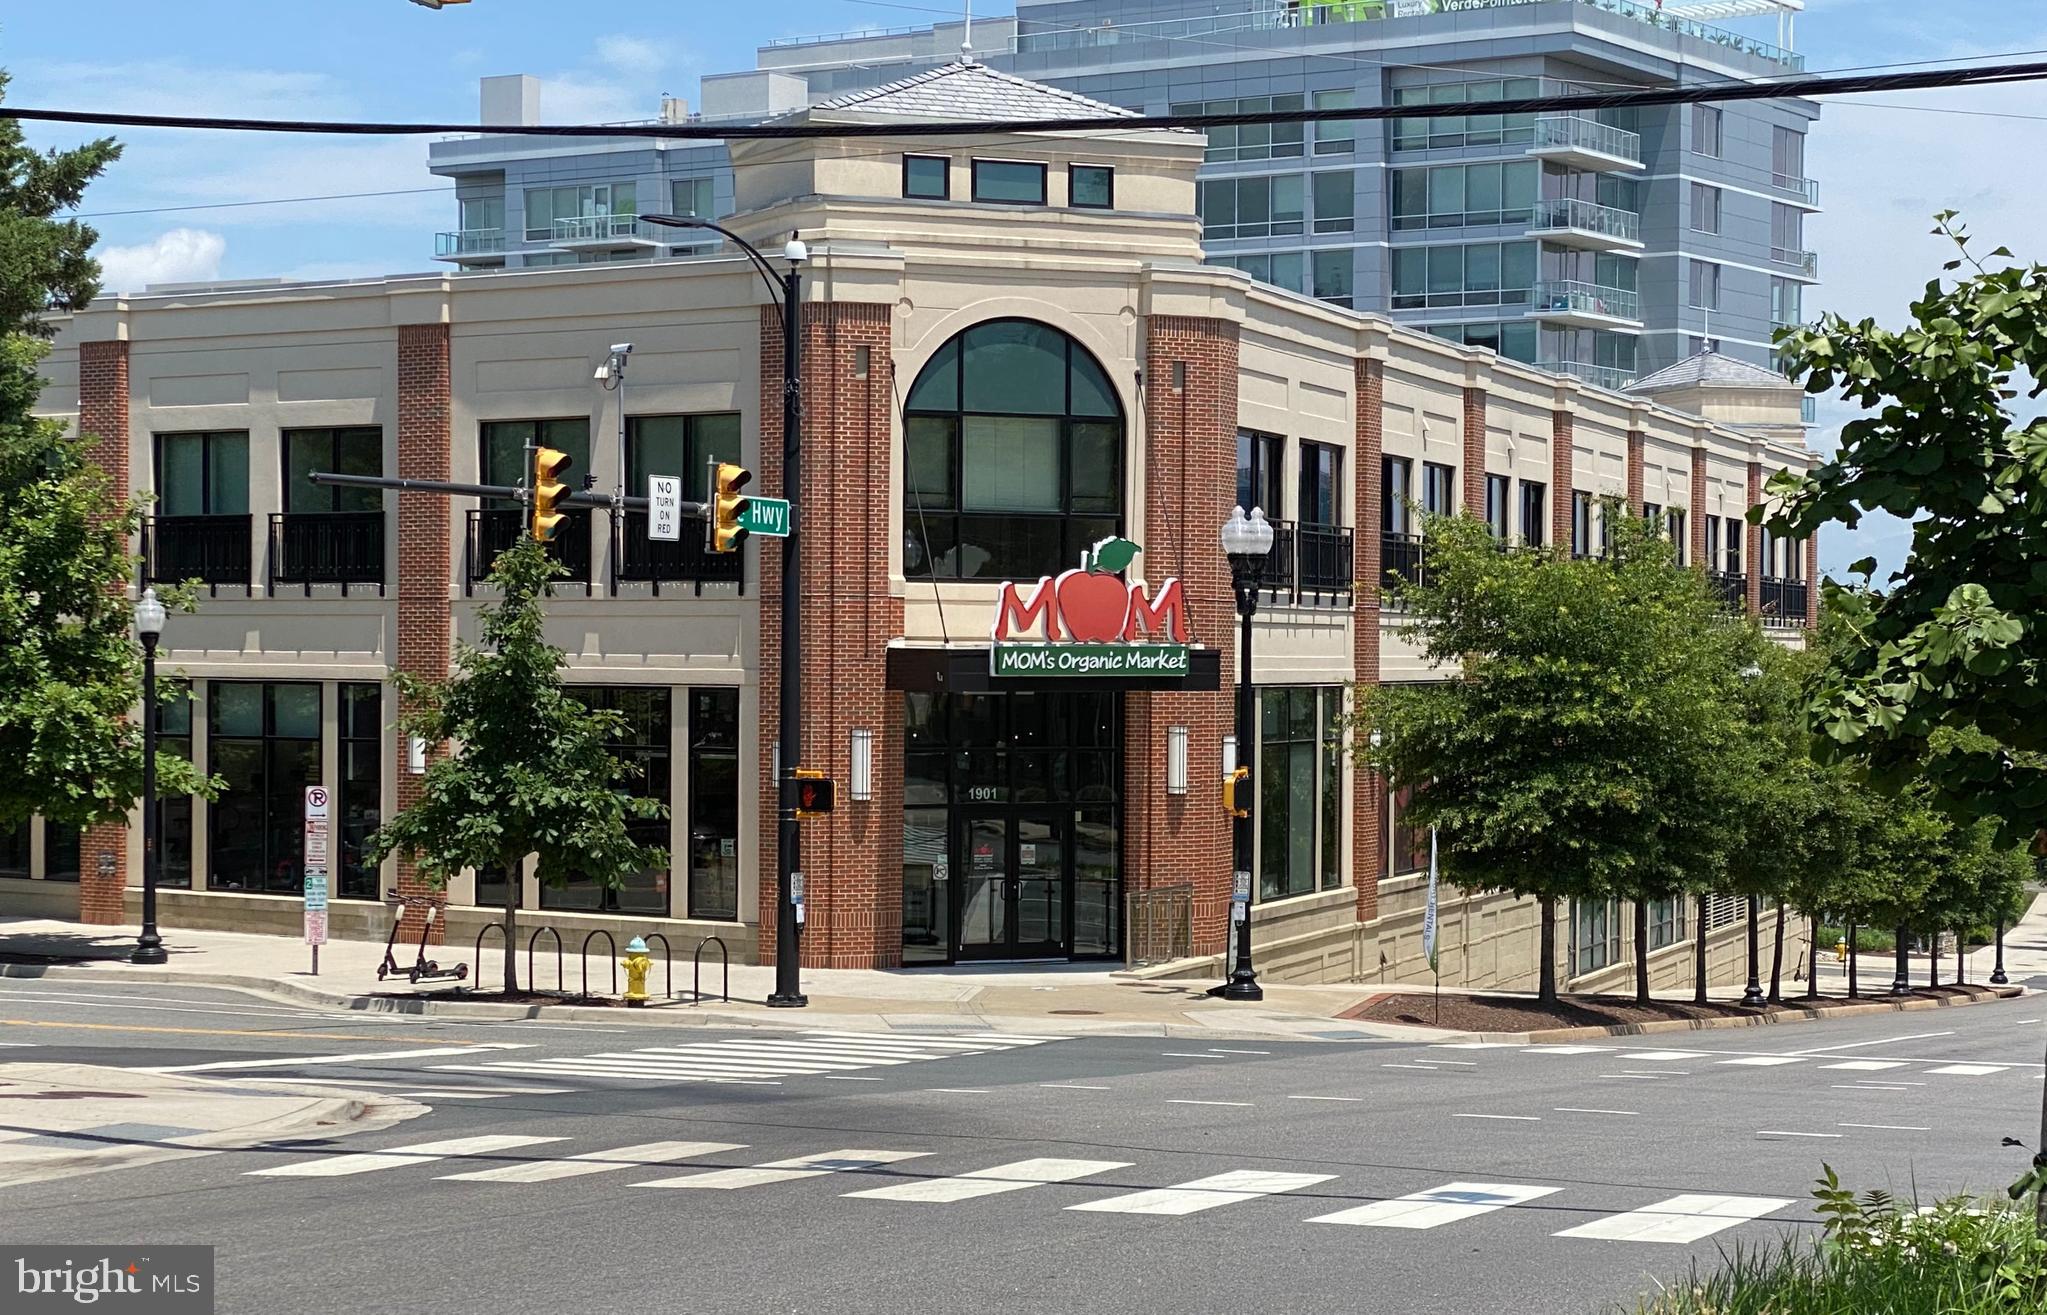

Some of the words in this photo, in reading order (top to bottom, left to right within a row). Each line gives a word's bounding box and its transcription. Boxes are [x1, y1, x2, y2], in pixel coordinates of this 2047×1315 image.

[657, 482, 672, 494] NO
[656, 496, 674, 507] TURN
[660, 510, 670, 520] ON
[752, 501, 784, 532] Hwy
[657, 523, 671, 534] RED
[1001, 650, 1055, 670] MOM's
[1058, 652, 1122, 672] Organic
[1125, 649, 1187, 669] Market
[968, 787, 998, 800] 1901
